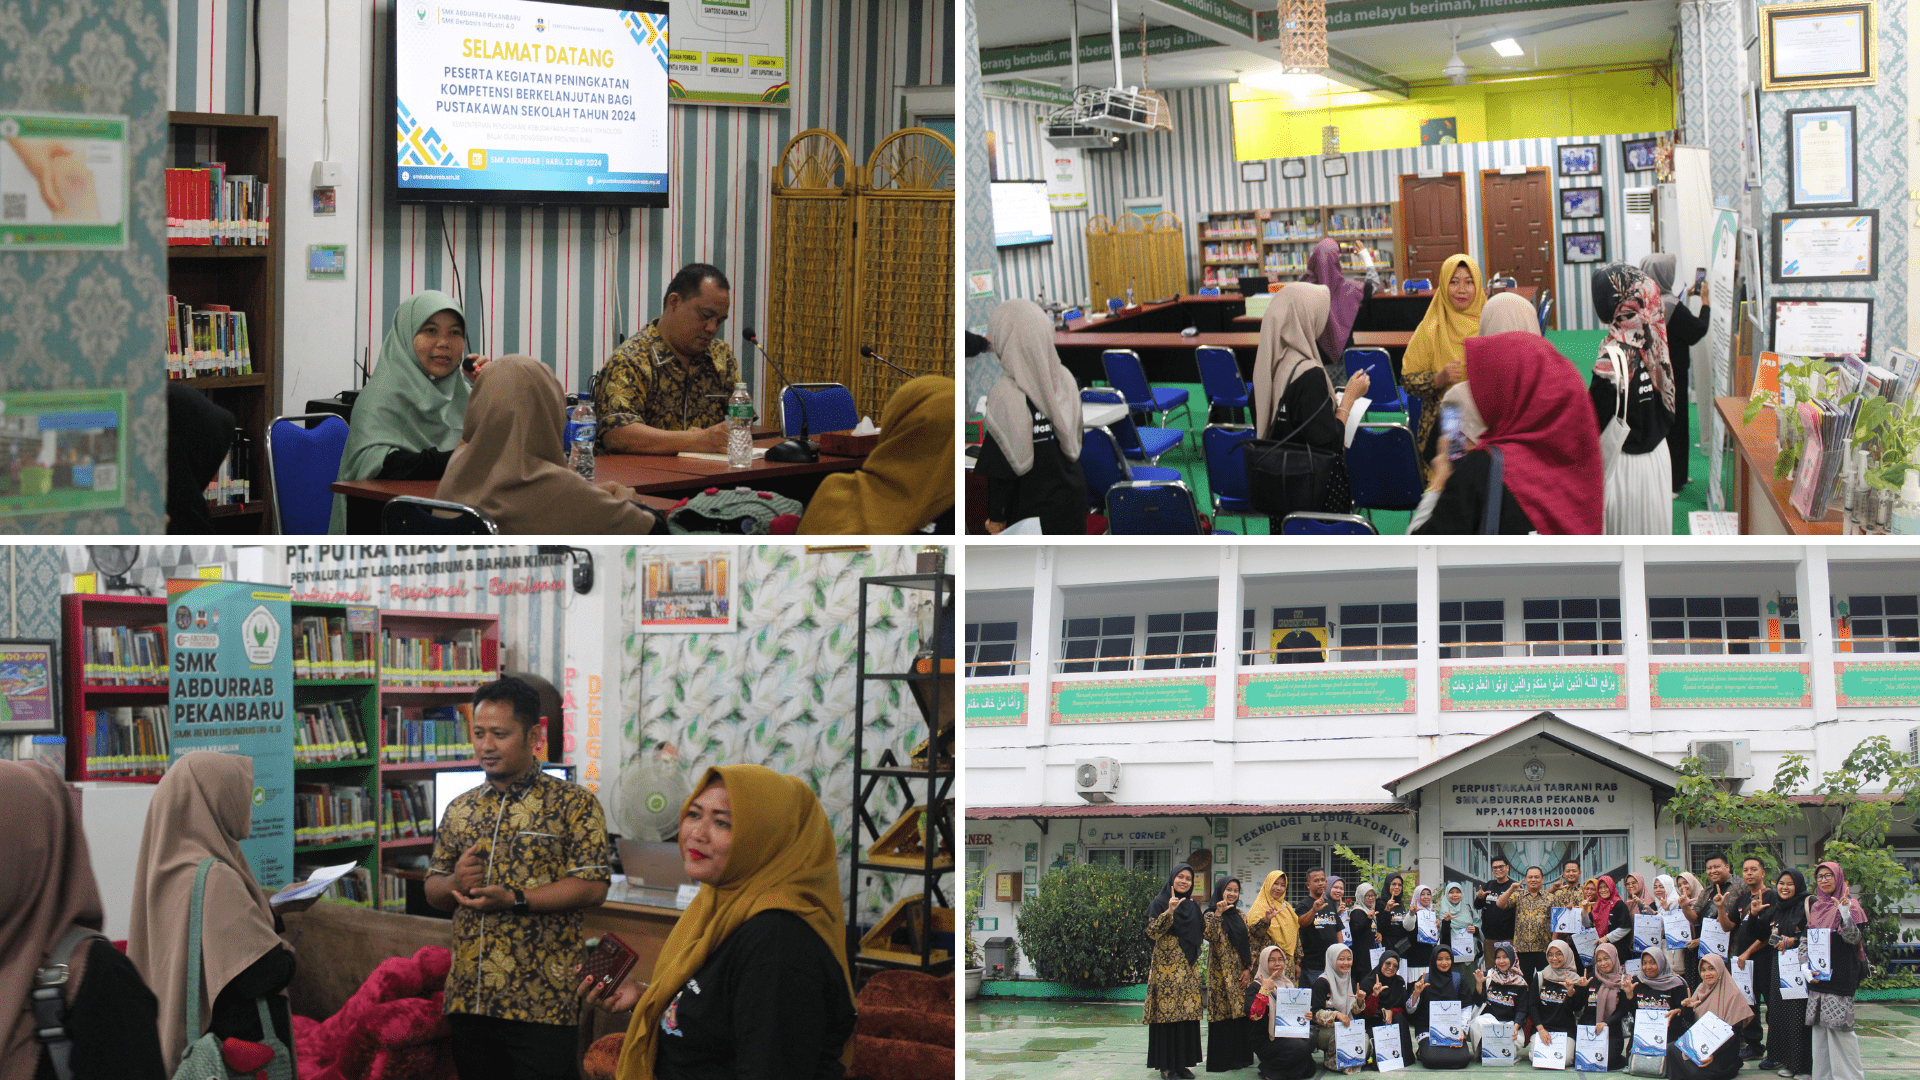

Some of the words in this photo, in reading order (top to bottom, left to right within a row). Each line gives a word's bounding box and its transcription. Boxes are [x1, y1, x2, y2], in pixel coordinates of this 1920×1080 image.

[441, 17, 455, 25] SMK
[1214, 7, 1222, 17] ia
[1222, 7, 1250, 29] berdiri.
[1325, 11, 1351, 25] nda
[1354, 6, 1407, 21] melayu
[1409, 0, 1476, 15] beriman,
[462, 37, 542, 62] SELAMAT
[545, 44, 614, 68] DATANG
[981, 58, 1012, 70] orang
[1013, 49, 1057, 66] berbudi,
[1137, 36, 1171, 53] orang
[1173, 34, 1184, 46] ia
[443, 66, 494, 81] PESERTA
[495, 69, 552, 85] KEGIATAN
[554, 74, 630, 90] PENINGKATAN
[440, 83, 514, 99] KOMPETENSI
[515, 88, 605, 104] BERKELANJUTAN
[607, 93, 633, 106] BAGI
[435, 100, 519, 116] PUSTAKAWAN
[520, 104, 571, 119] SEKOLAH
[572, 107, 609, 121] TAHUN
[611, 109, 637, 122] 2024
[490, 156, 504, 165] SMK
[505, 156, 541, 166] ABDURRAB
[545, 158, 565, 168] RABU,
[566, 159, 575, 167] 22
[286, 546, 312, 565] PT.
[318, 545, 388, 563] PUTRA
[290, 571, 341, 584] PENYALUR
[342, 567, 369, 580] ALAT
[371, 559, 464, 577] LABORATORIUM
[465, 559, 475, 571] &
[476, 556, 521, 573] BAHAN
[524, 554, 563, 568] KIMIA
[174, 652, 219, 674] SMK
[174, 677, 274, 698] ABDURRAB
[174, 701, 284, 725] PEKANBARU
[174, 729, 193, 740] SMK
[193, 726, 231, 738] REVOLUSI
[1452, 784, 1541, 793] PERPUSTAKAAN
[1544, 783, 1592, 792] TABRANI
[1595, 783, 1618, 791] RAB
[1456, 796, 1480, 804] SMK
[1481, 795, 1543, 804] ABDURRAB
[1476, 807, 1595, 816] NPP.1471081H2000006
[1235, 816, 1303, 847] TEKNOLOGI
[1310, 815, 1410, 848] LABORATORIUM
[1497, 818, 1563, 828] AKREDITASI
[1566, 818, 1574, 827] A
[965, 833, 994, 846] RNER
[1104, 832, 1124, 841] TLM
[1129, 832, 1167, 840] CORNER
[1301, 832, 1350, 842] MEDIK
